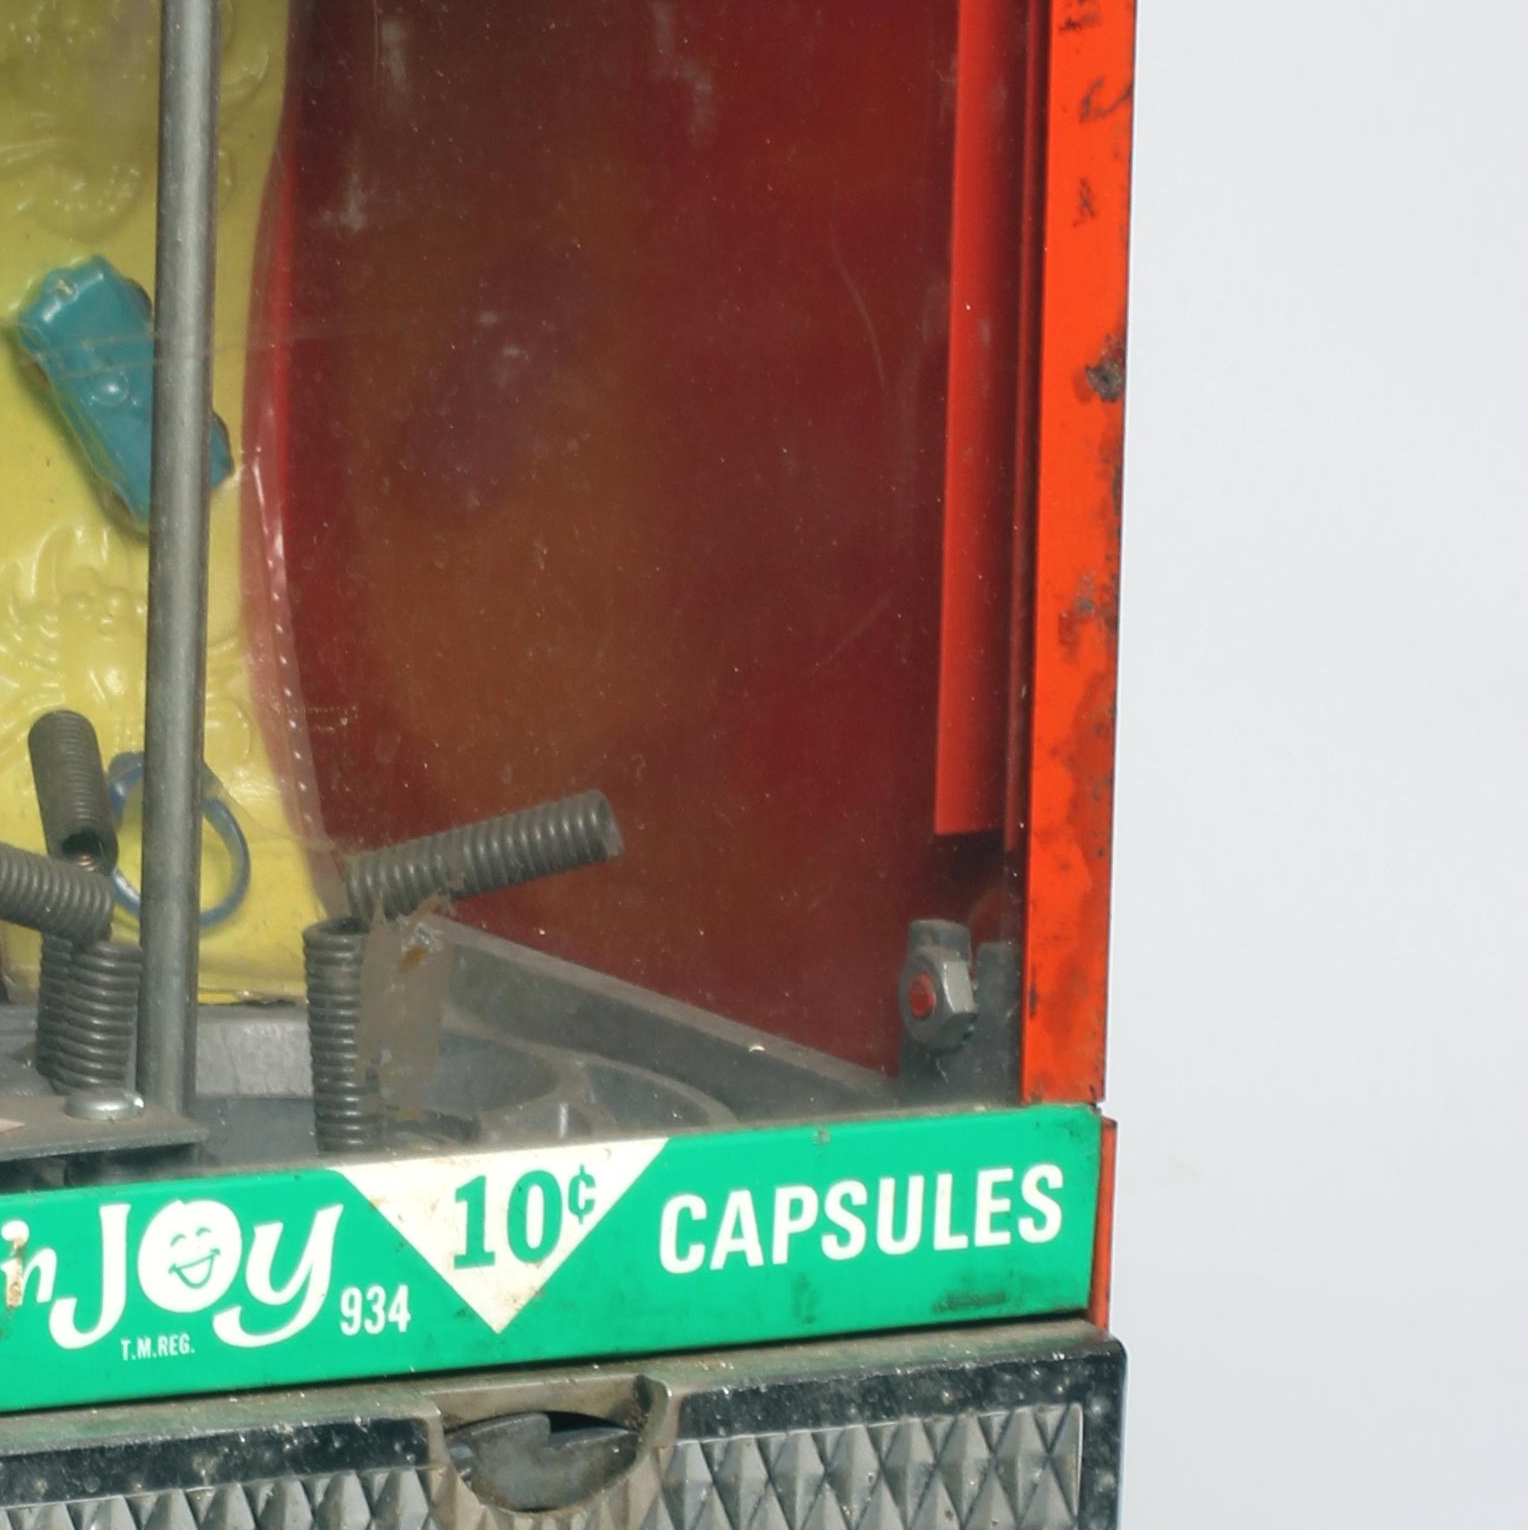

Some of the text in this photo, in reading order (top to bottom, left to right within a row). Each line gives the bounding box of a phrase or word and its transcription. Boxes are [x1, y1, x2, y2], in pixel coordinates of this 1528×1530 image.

[453, 1166, 596, 1269] 10¢
[659, 1163, 1064, 1273] CAPSULES
[340, 1285, 412, 1336] 934
